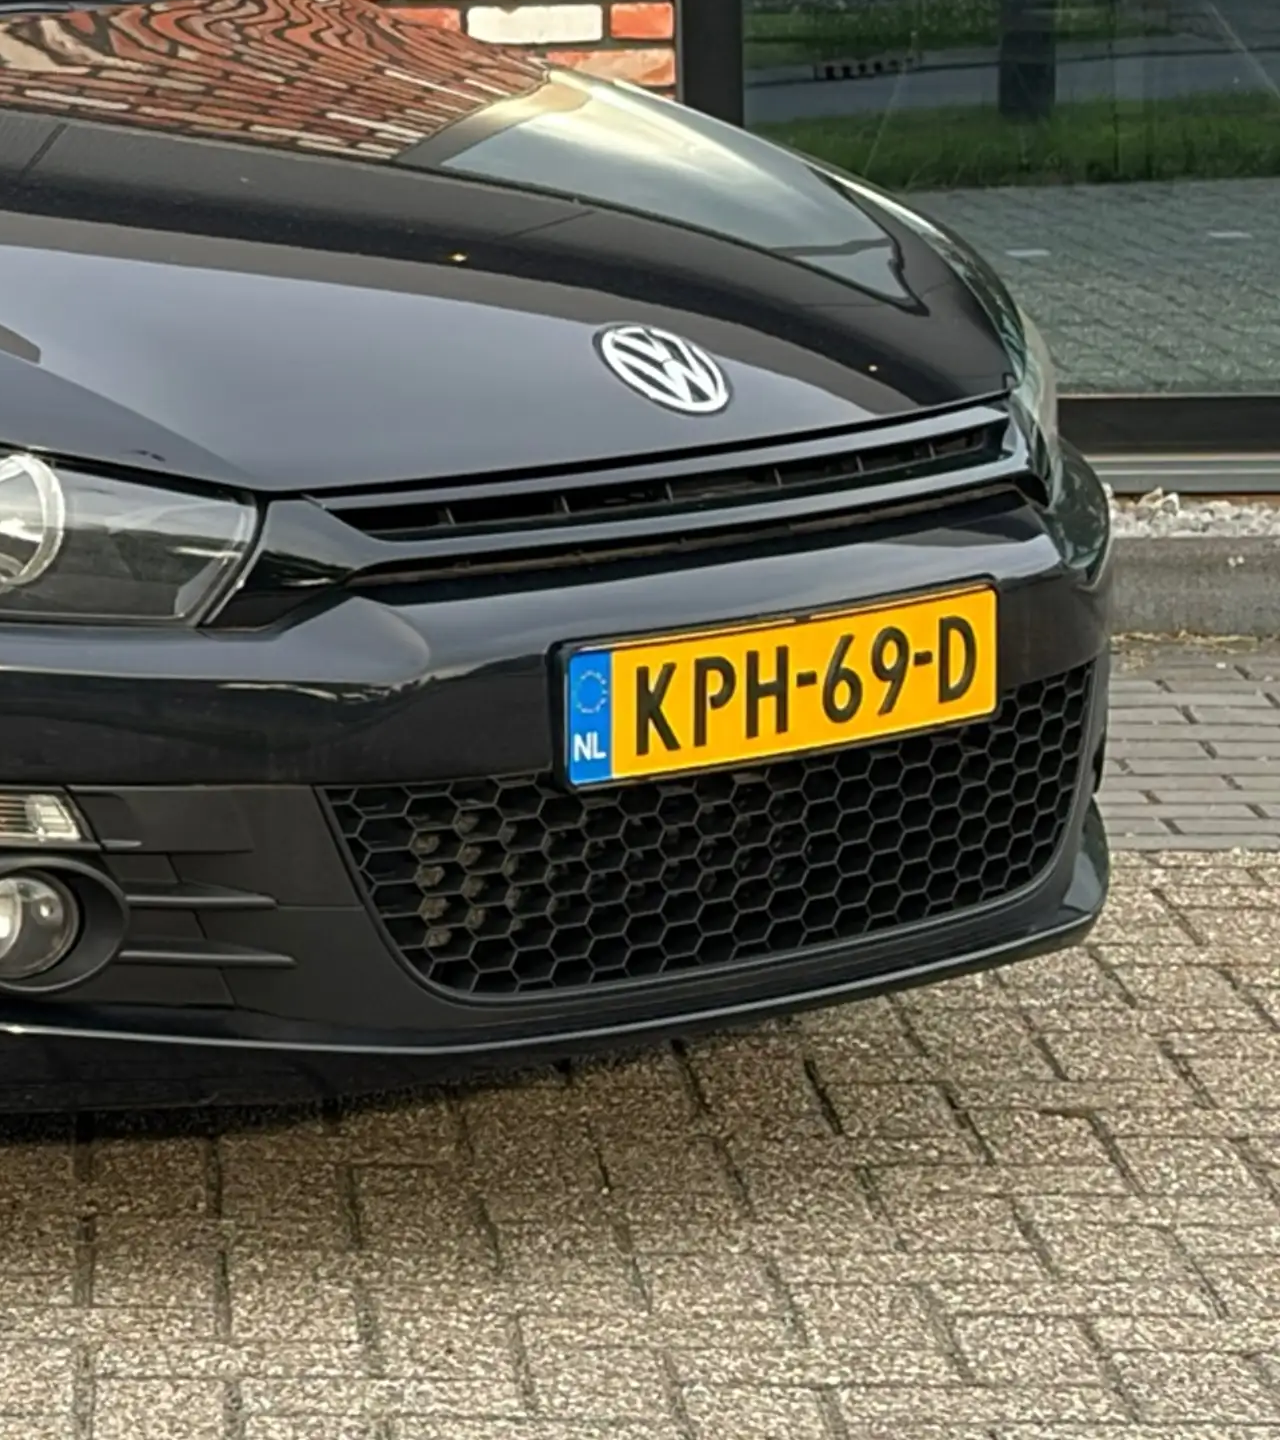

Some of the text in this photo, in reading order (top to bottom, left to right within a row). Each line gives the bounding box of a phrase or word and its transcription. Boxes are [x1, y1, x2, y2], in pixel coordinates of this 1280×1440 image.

[601, 326, 729, 413] VW
[636, 615, 977, 757] KPH-69-D
[573, 730, 607, 762] NL
